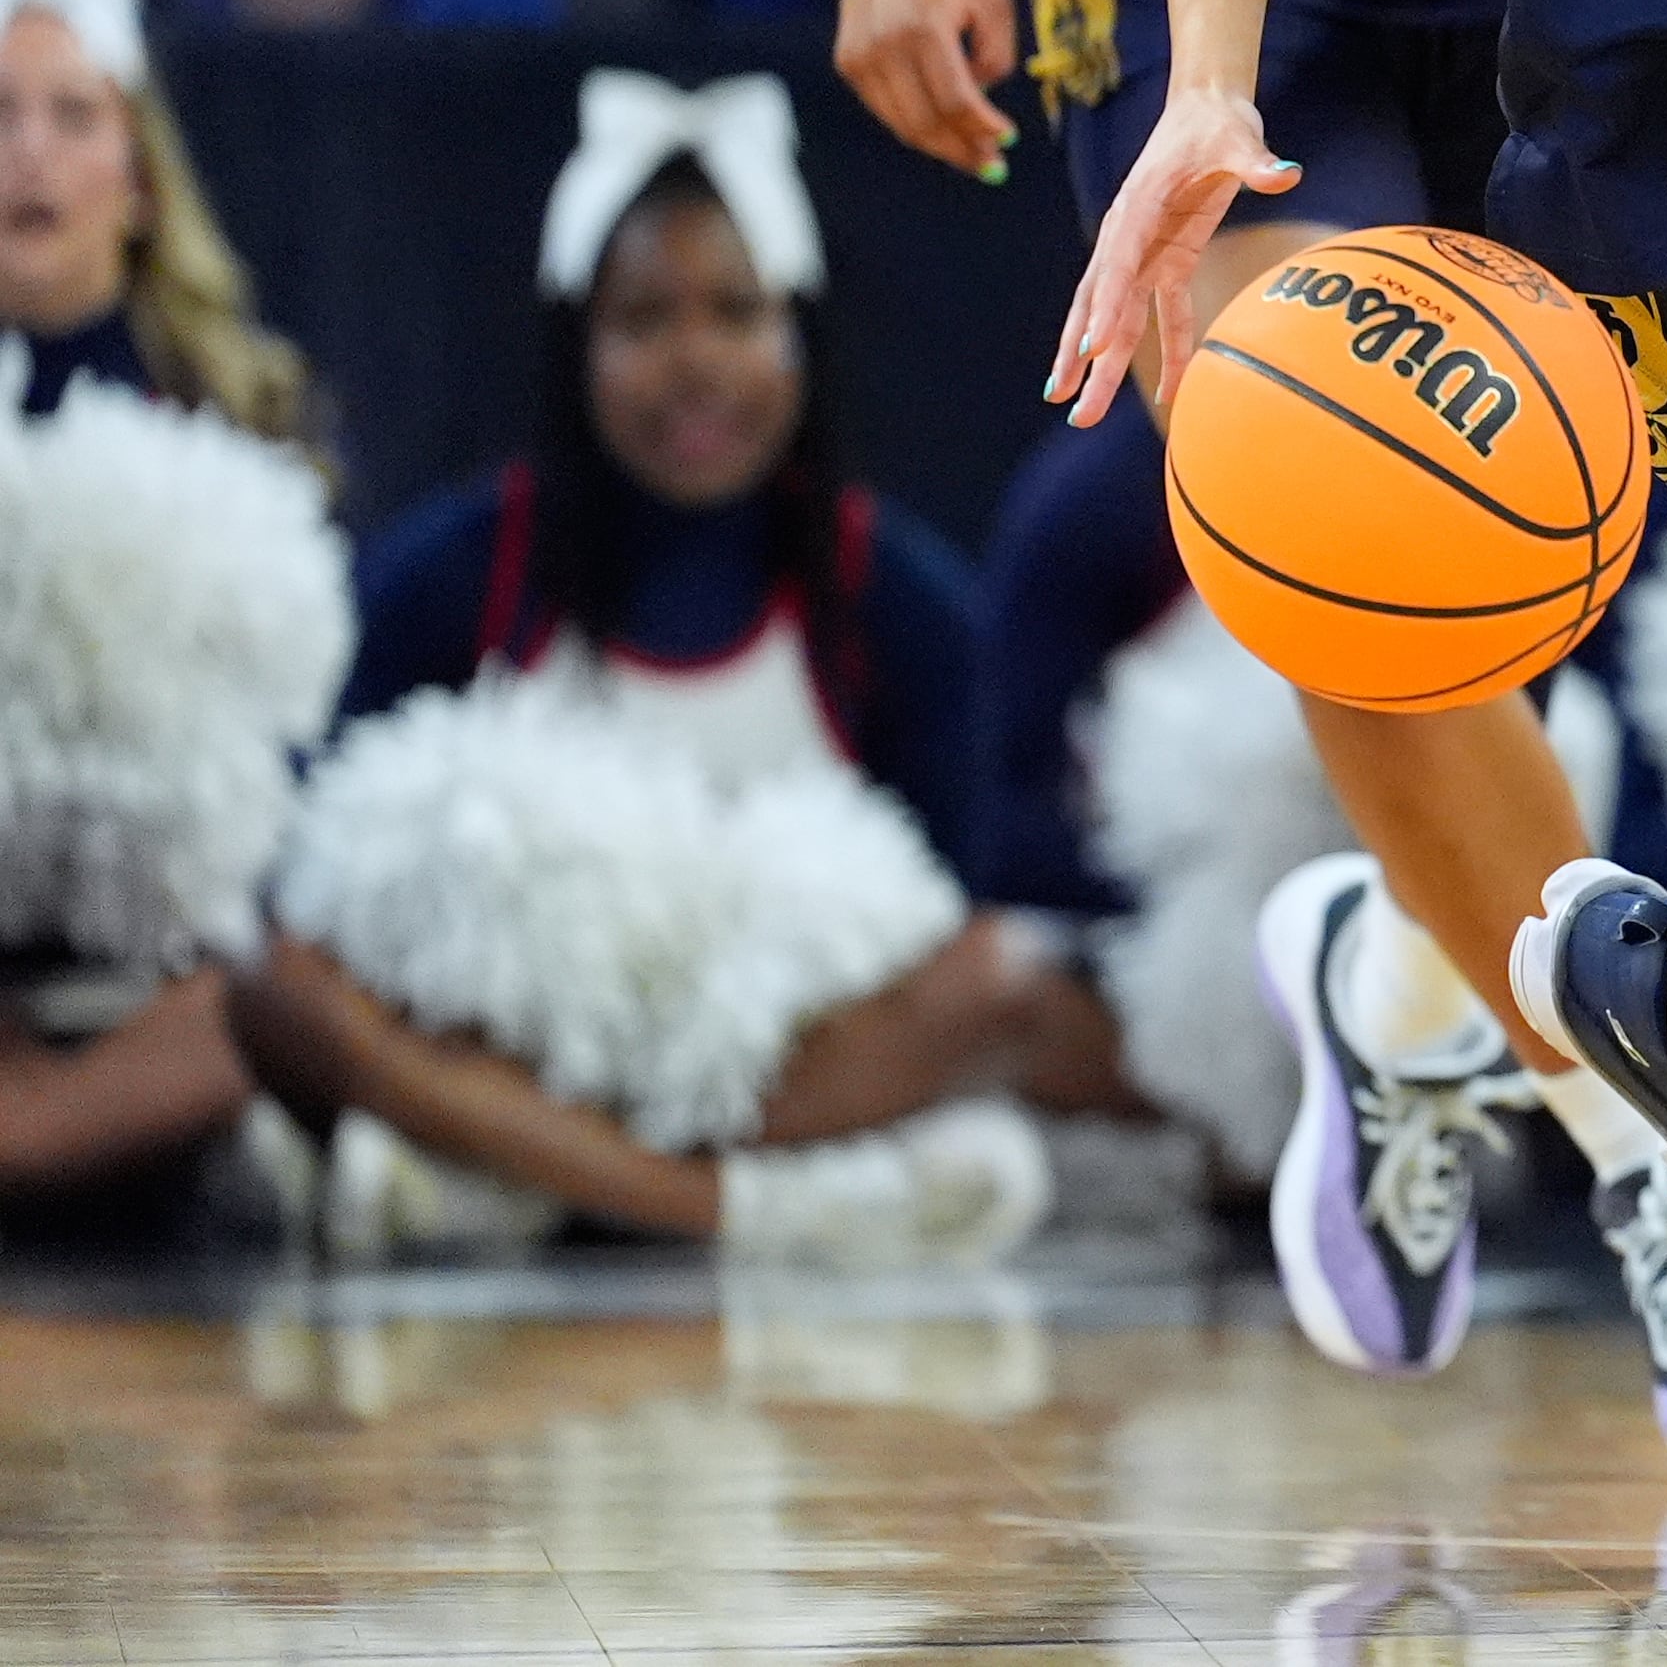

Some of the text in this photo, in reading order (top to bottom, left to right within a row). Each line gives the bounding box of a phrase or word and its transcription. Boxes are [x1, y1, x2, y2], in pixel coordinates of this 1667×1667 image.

[1369, 273, 1457, 324] EVO NXT
[1261, 265, 1522, 463] Wilson
